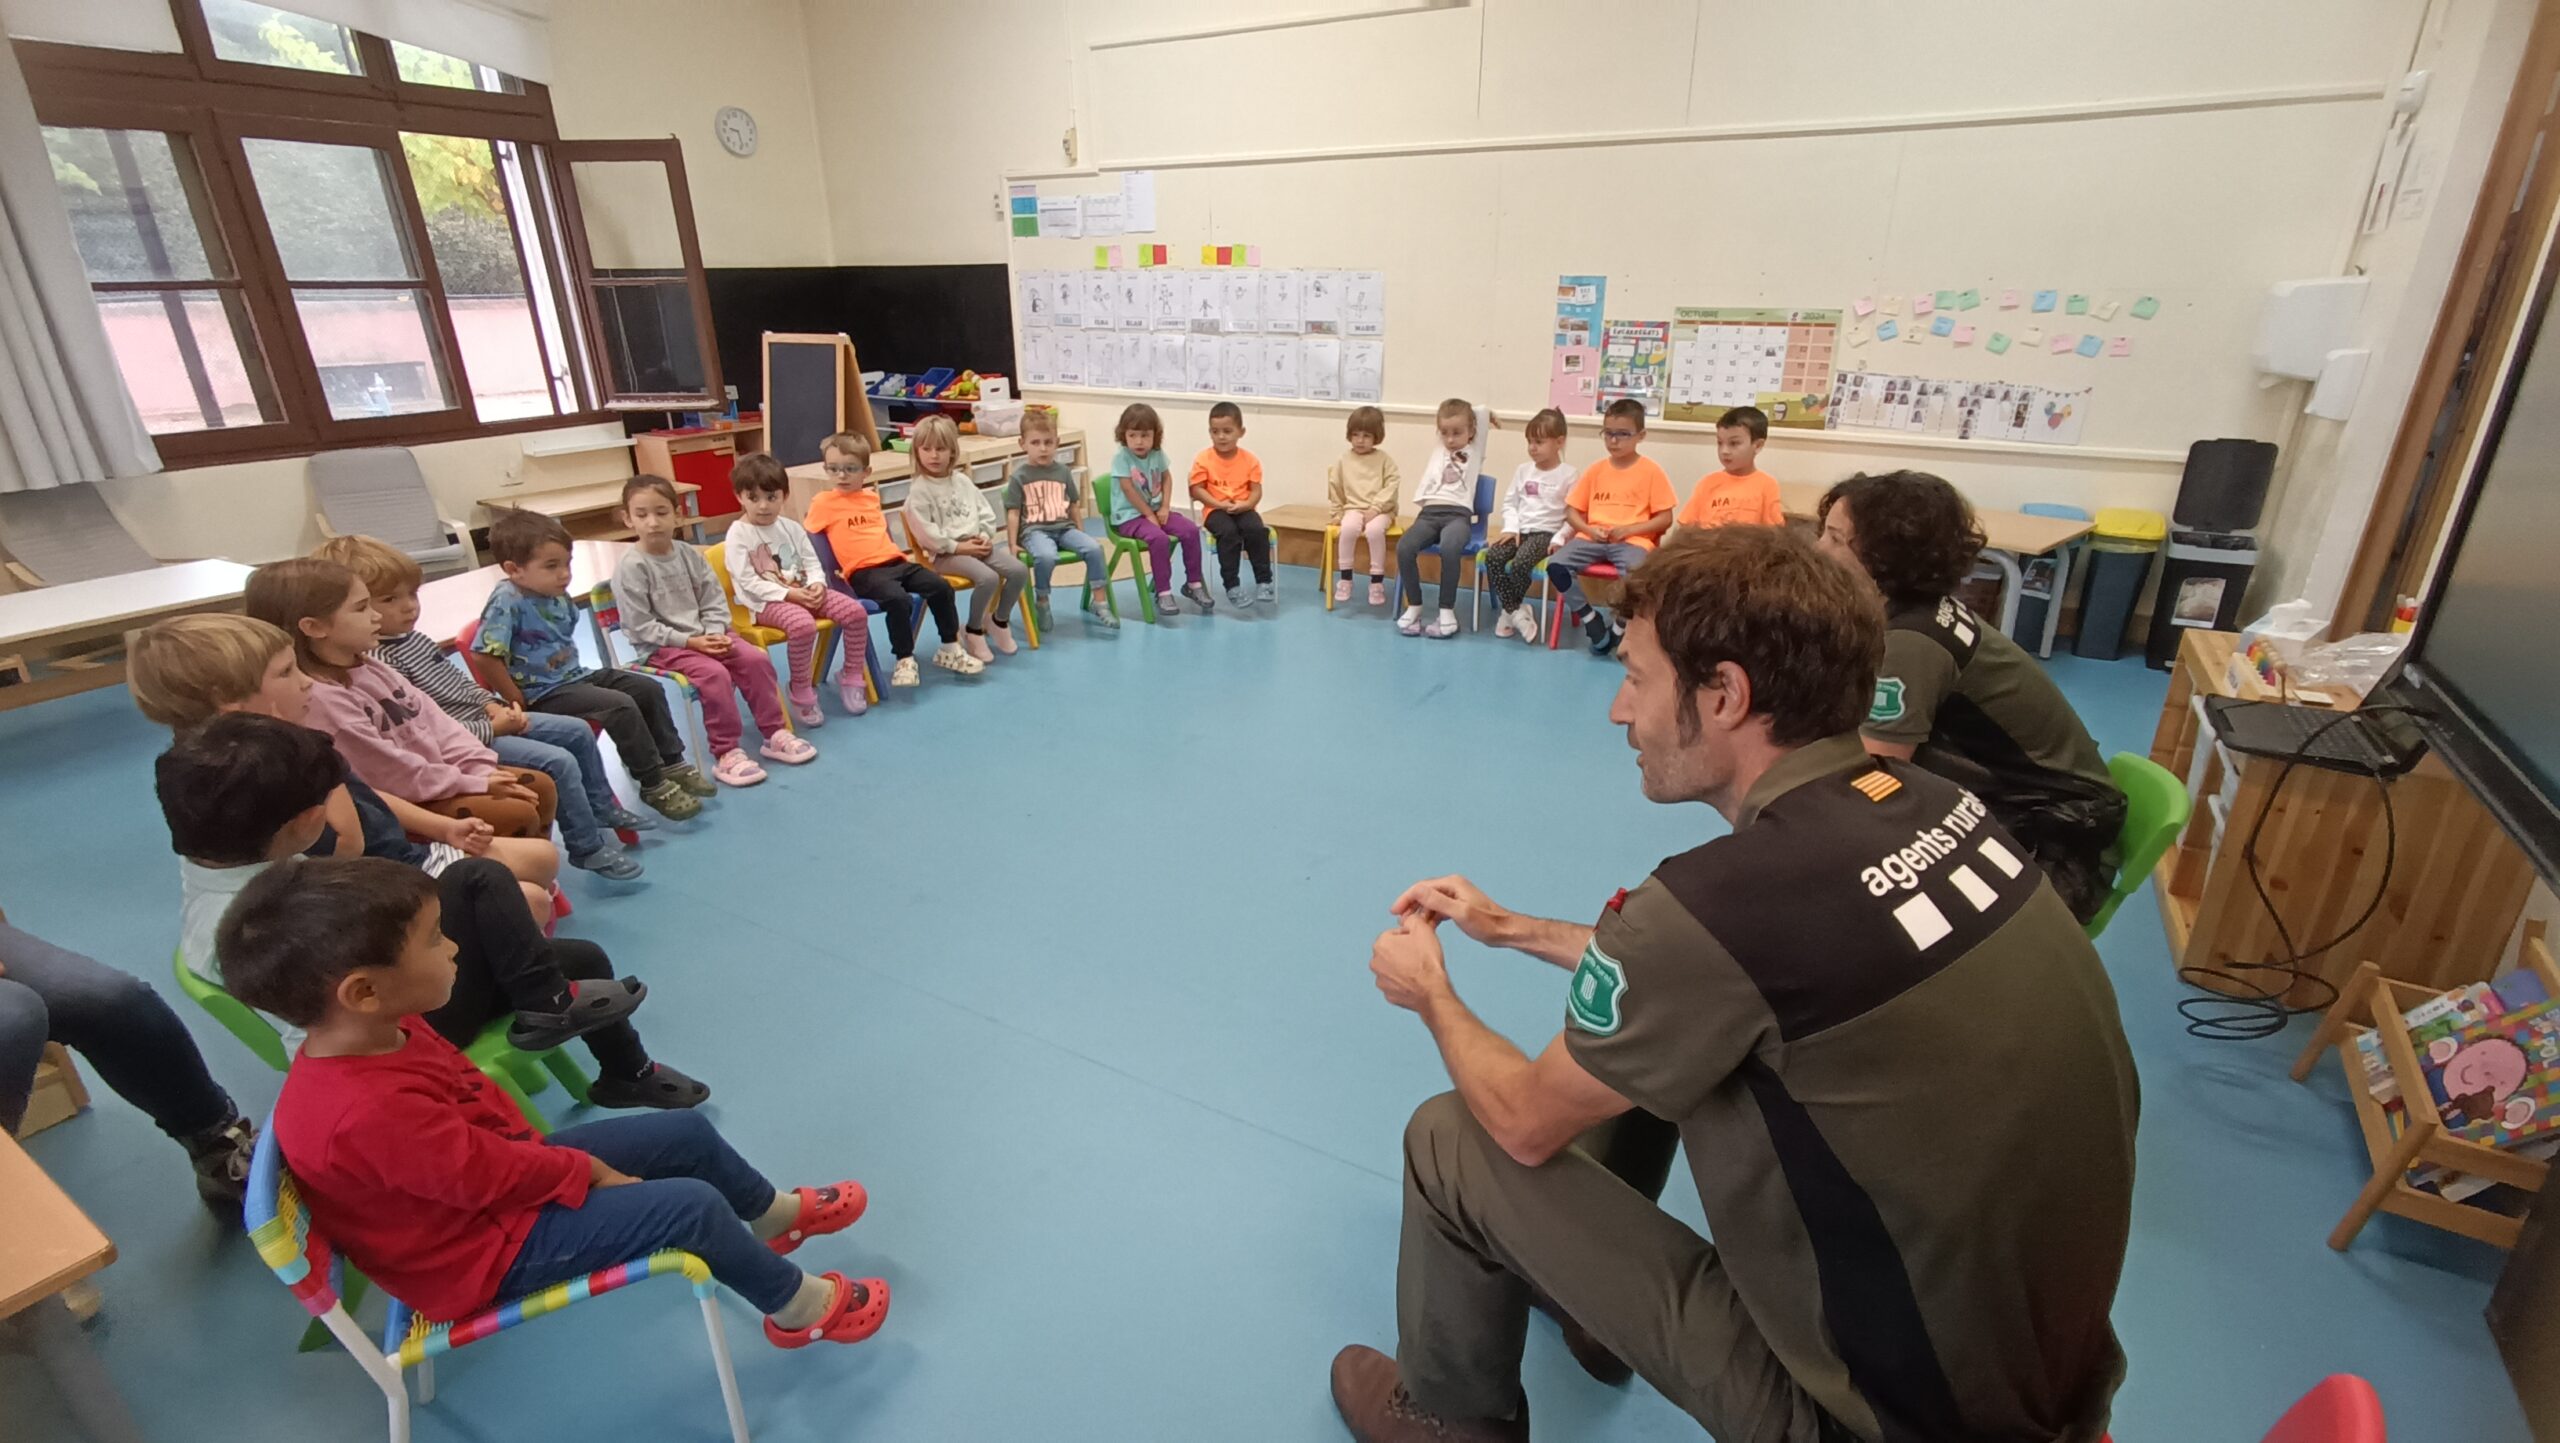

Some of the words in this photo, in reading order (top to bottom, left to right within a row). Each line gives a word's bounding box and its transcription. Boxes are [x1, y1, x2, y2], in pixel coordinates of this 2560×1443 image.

[1680, 310, 1719, 318] OCTUBRE
[1803, 311, 1825, 320] 2024
[1861, 828, 1958, 896] agents
[1942, 787, 1987, 839] rural
